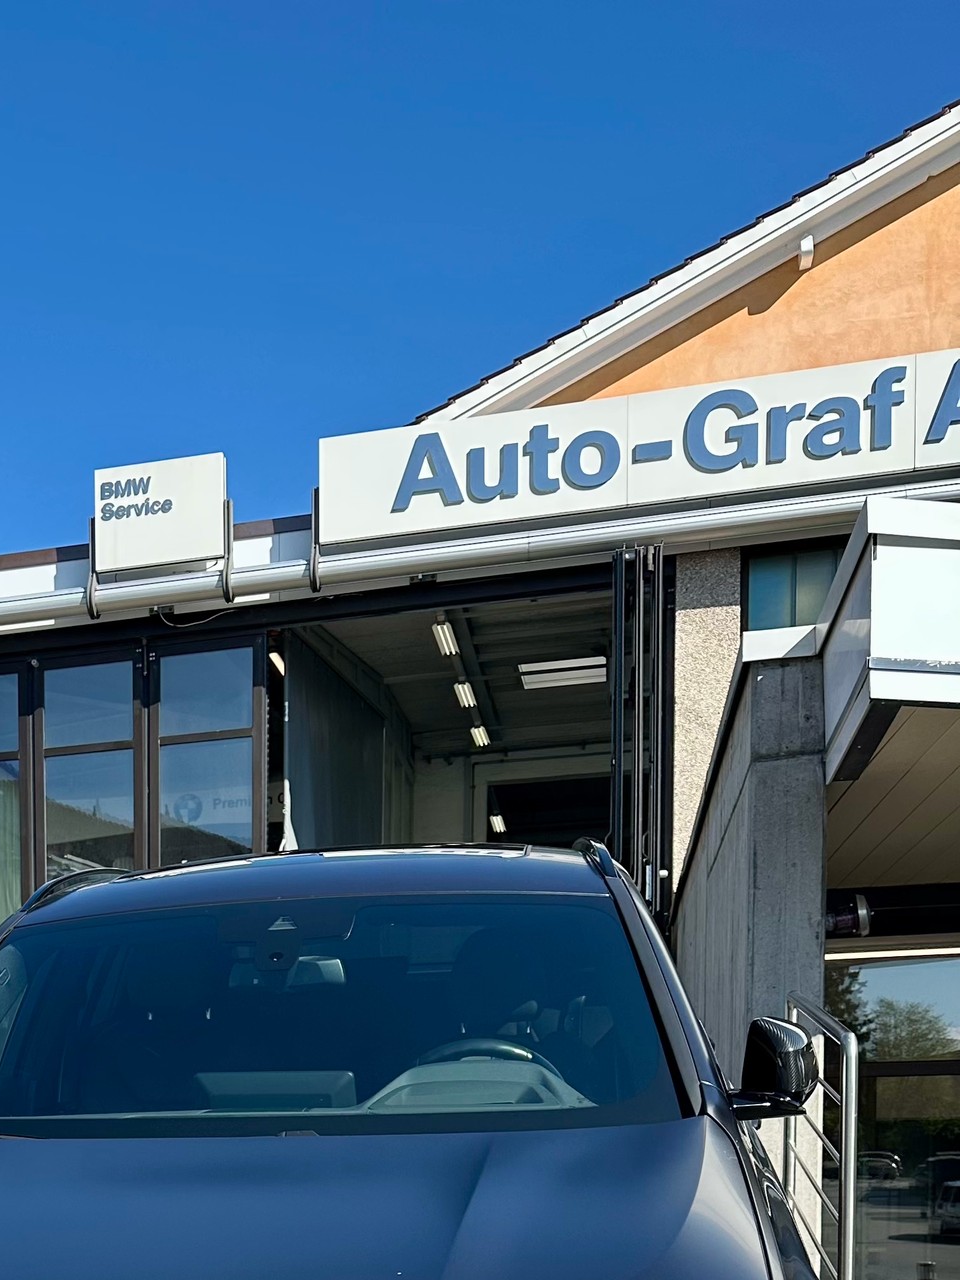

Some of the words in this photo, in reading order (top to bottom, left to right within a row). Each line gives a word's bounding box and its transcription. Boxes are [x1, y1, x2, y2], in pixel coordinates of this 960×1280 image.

[390, 366, 907, 513] Auto-Graf
[101, 476, 151, 500] BMW
[101, 498, 173, 521] Service
